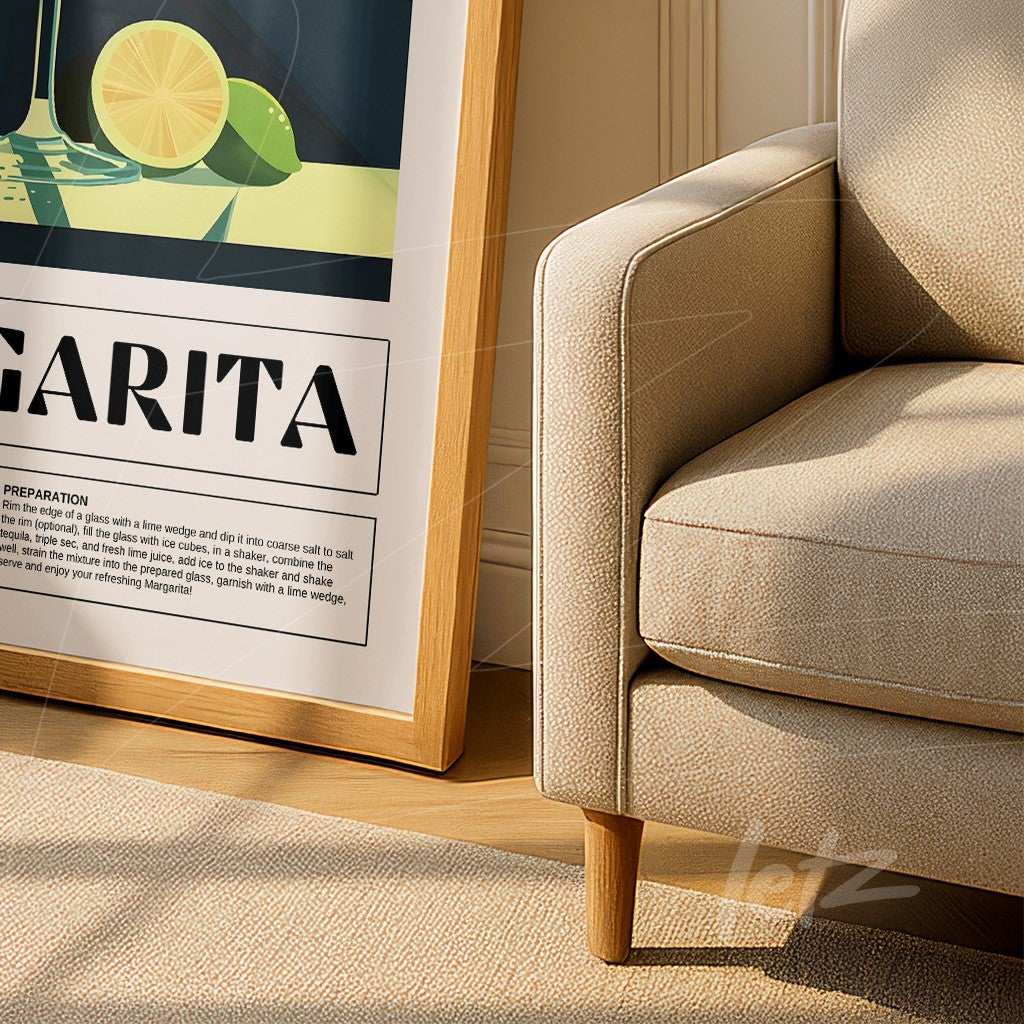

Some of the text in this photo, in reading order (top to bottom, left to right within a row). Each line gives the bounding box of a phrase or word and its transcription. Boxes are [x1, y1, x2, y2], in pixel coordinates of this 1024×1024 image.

[3, 484, 89, 506] PREPARATION
[1, 513, 16, 524] the
[17, 515, 33, 527] rim
[82, 525, 94, 536] fill
[95, 527, 111, 538] the
[112, 530, 138, 543] glass
[139, 535, 159, 546] with
[161, 537, 176, 548] ice
[178, 541, 210, 554] cubes,
[212, 544, 222, 555] in
[224, 548, 231, 557] a
[233, 548, 270, 563] shaker,
[271, 555, 315, 569] combine
[317, 560, 334, 572] the
[2, 499, 354, 560] Rim the edge of a glass with a lime wedge and dip it into coarse salt to salt
[21, 546, 48, 558] strain
[49, 549, 64, 560] the
[65, 552, 101, 566] mixture
[102, 557, 121, 569] into
[122, 560, 138, 572] the
[139, 565, 184, 578] prepared
[185, 570, 214, 585] glass,
[216, 576, 253, 589] garnish
[254, 581, 276, 593] with
[277, 586, 285, 595] a
[287, 585, 308, 598] lime
[310, 590, 347, 605] wedge,
[24, 561, 43, 572] and
[44, 564, 71, 578] enjoy
[71, 569, 94, 579] your
[94, 572, 142, 589] refreshing
[144, 578, 193, 595] Margarita!
[35, 533, 58, 546] triple
[59, 538, 79, 550] sec,
[81, 541, 100, 552] and
[101, 542, 126, 555] fresh
[127, 546, 148, 559] lime
[177, 555, 197, 566] add
[198, 557, 213, 569] ice
[215, 560, 225, 570] to
[227, 561, 243, 573] the
[244, 564, 280, 578] shaker
[281, 571, 301, 582] and
[302, 573, 334, 587] shake
